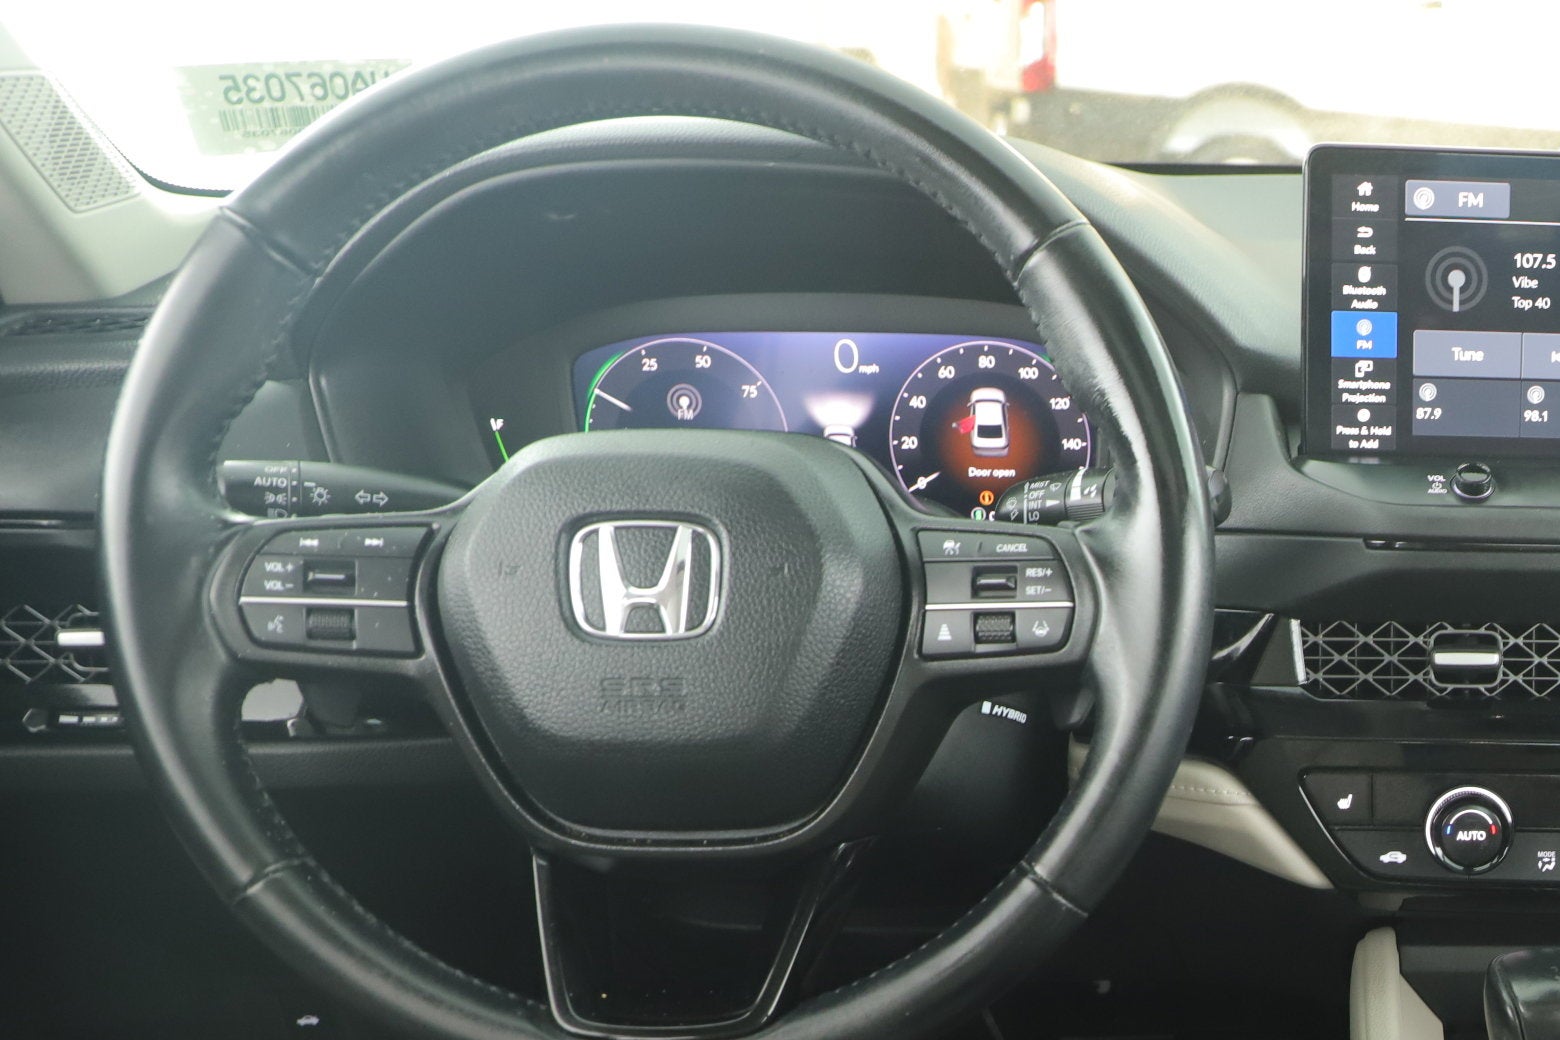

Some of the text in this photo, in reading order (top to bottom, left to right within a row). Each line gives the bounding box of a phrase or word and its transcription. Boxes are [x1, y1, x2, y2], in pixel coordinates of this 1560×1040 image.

[1458, 191, 1484, 208] FM
[1351, 201, 1380, 212] Home
[1353, 244, 1377, 255] Back
[1513, 252, 1557, 270] 107.5
[1512, 275, 1539, 289] Vibe
[1342, 284, 1387, 296] Bluetooth
[1350, 298, 1379, 309] Audio
[1511, 296, 1551, 311] Top 40
[1356, 339, 1373, 350] FM
[833, 338, 859, 374] 0
[1451, 346, 1485, 362] Tune
[641, 358, 658, 371] 25
[695, 355, 712, 368] 50
[978, 355, 996, 369] 80
[858, 363, 880, 375] mph
[937, 366, 955, 379] 60
[1018, 367, 1039, 379] 100
[1337, 379, 1391, 391] Smartphone
[741, 385, 758, 398] 75
[909, 395, 927, 409] 40
[1049, 397, 1071, 410] 120
[677, 408, 694, 420] FM
[1415, 407, 1442, 420] 87.9
[1523, 410, 1549, 422] 98.1
[900, 436, 918, 449] 20
[1061, 438, 1082, 450] 140
[968, 467, 1015, 479] Door open
[1427, 474, 1446, 482] VOL
[253, 477, 287, 488] AUTO
[1028, 489, 1045, 499] OFF
[1028, 499, 1042, 510] INT
[1028, 511, 1040, 522] LO
[995, 543, 1028, 553] CANCEL
[991, 704, 1028, 724] HYBRID
[1456, 830, 1487, 841] AUTO
[1537, 850, 1556, 858] MODE
